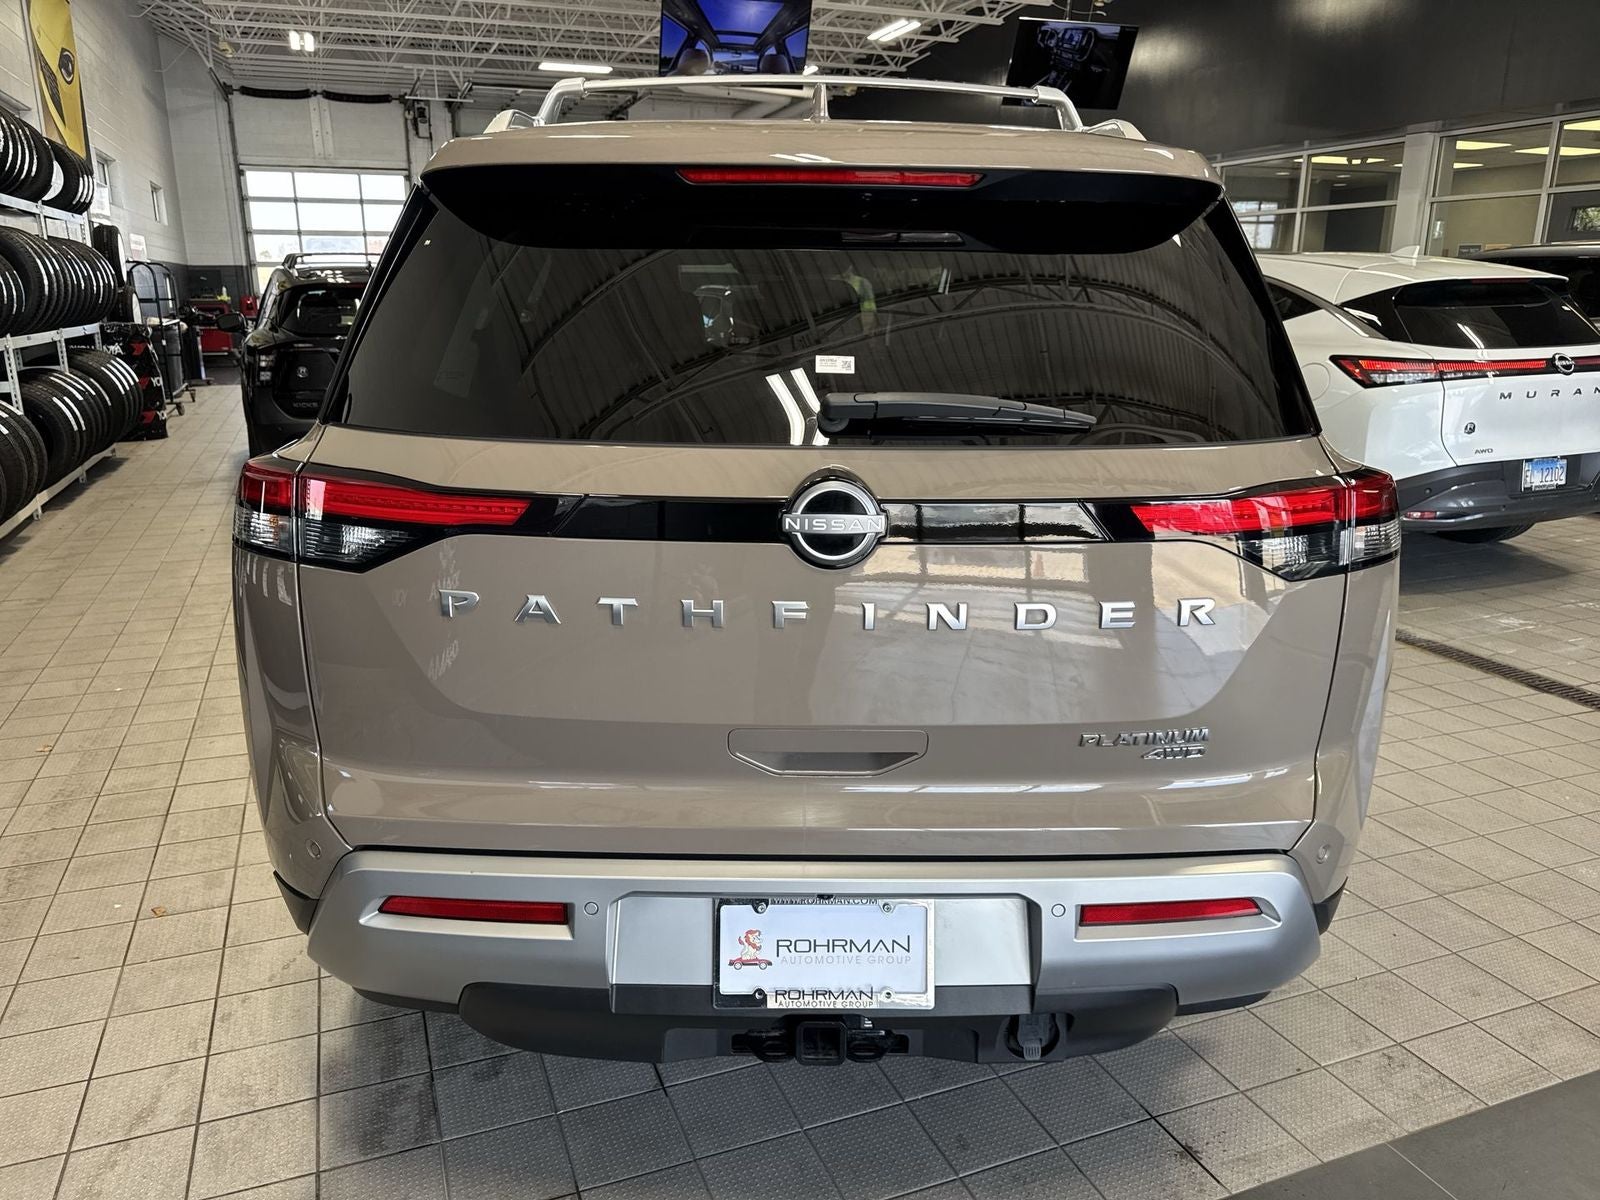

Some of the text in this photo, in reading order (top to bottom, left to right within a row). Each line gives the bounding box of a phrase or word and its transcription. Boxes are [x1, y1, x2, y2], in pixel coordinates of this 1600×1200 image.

[1540, 466, 1564, 483] 12102
[785, 518, 882, 531] NISSAN
[439, 589, 1216, 631] PATHFINDER
[1078, 727, 1208, 746] PLATINUM
[1141, 746, 1206, 760] 4WD
[776, 935, 910, 957] ROHRMAN
[780, 955, 911, 965] AUTOMOTIVE GROUP
[775, 986, 873, 1003] ROHRMAN
